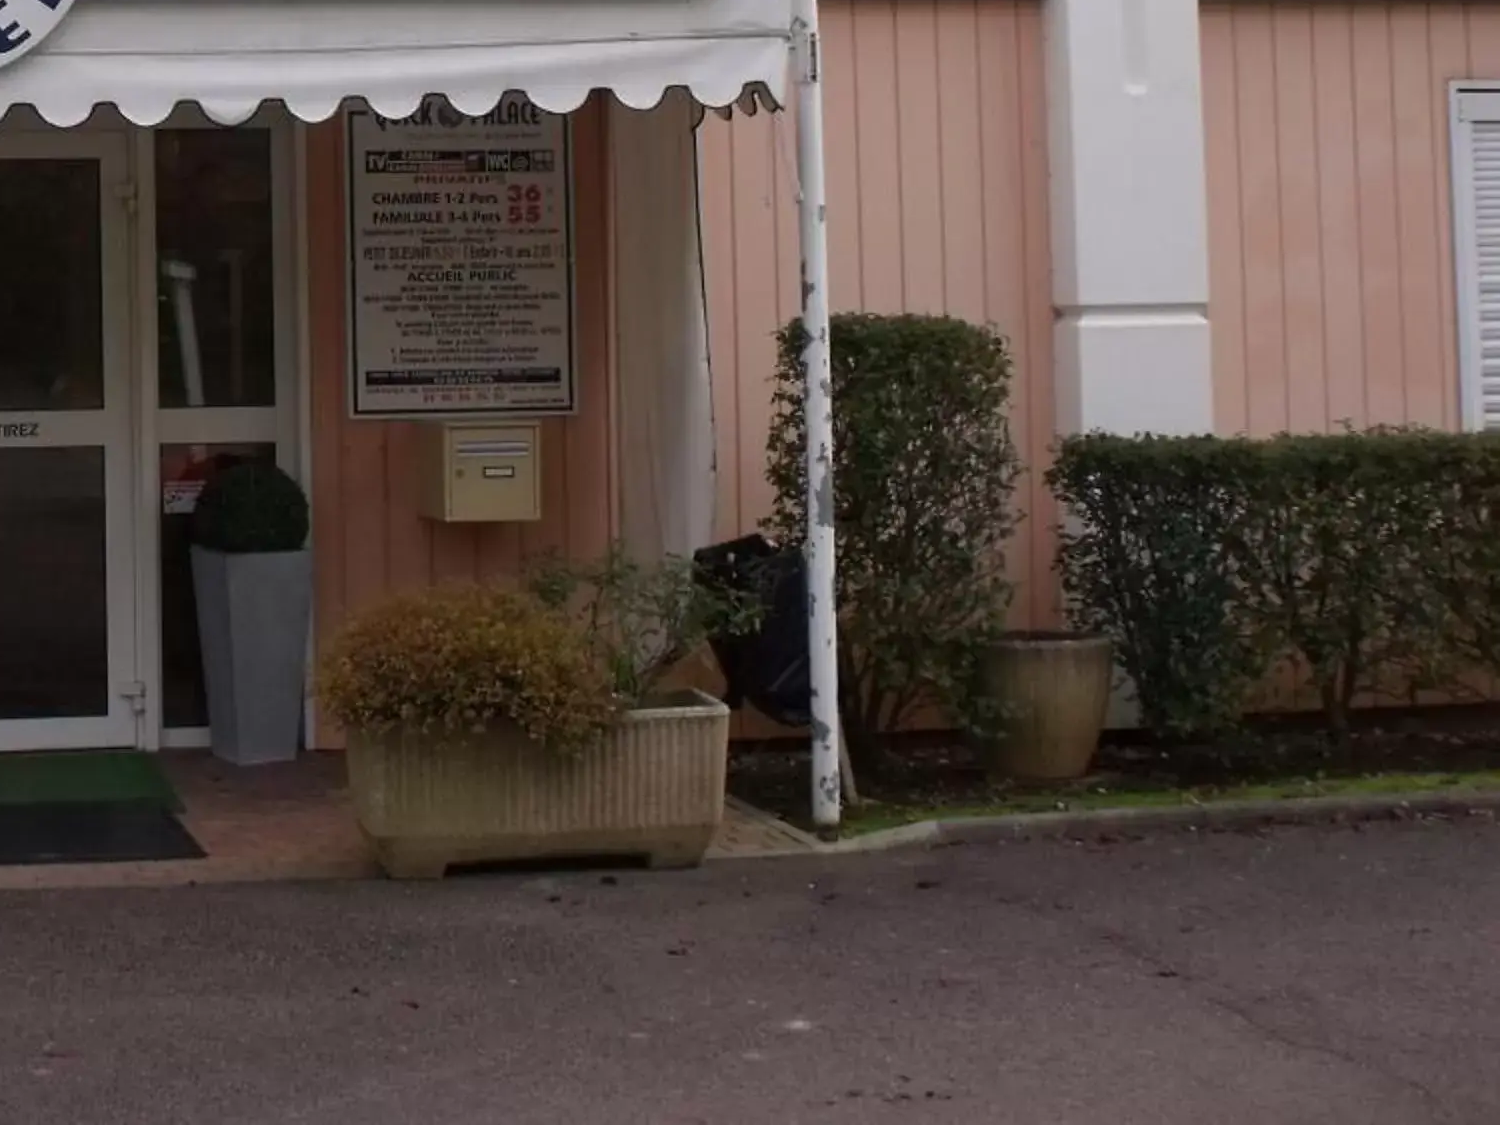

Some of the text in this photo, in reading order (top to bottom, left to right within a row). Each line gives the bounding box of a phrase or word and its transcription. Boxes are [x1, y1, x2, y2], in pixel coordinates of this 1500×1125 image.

[372, 184, 542, 205] CHAMBRE 1-2 Pers 36
[372, 210, 443, 224] FAMILIALE
[506, 205, 542, 223] 55
[406, 269, 517, 282] ACCUEIL PUBLIC
